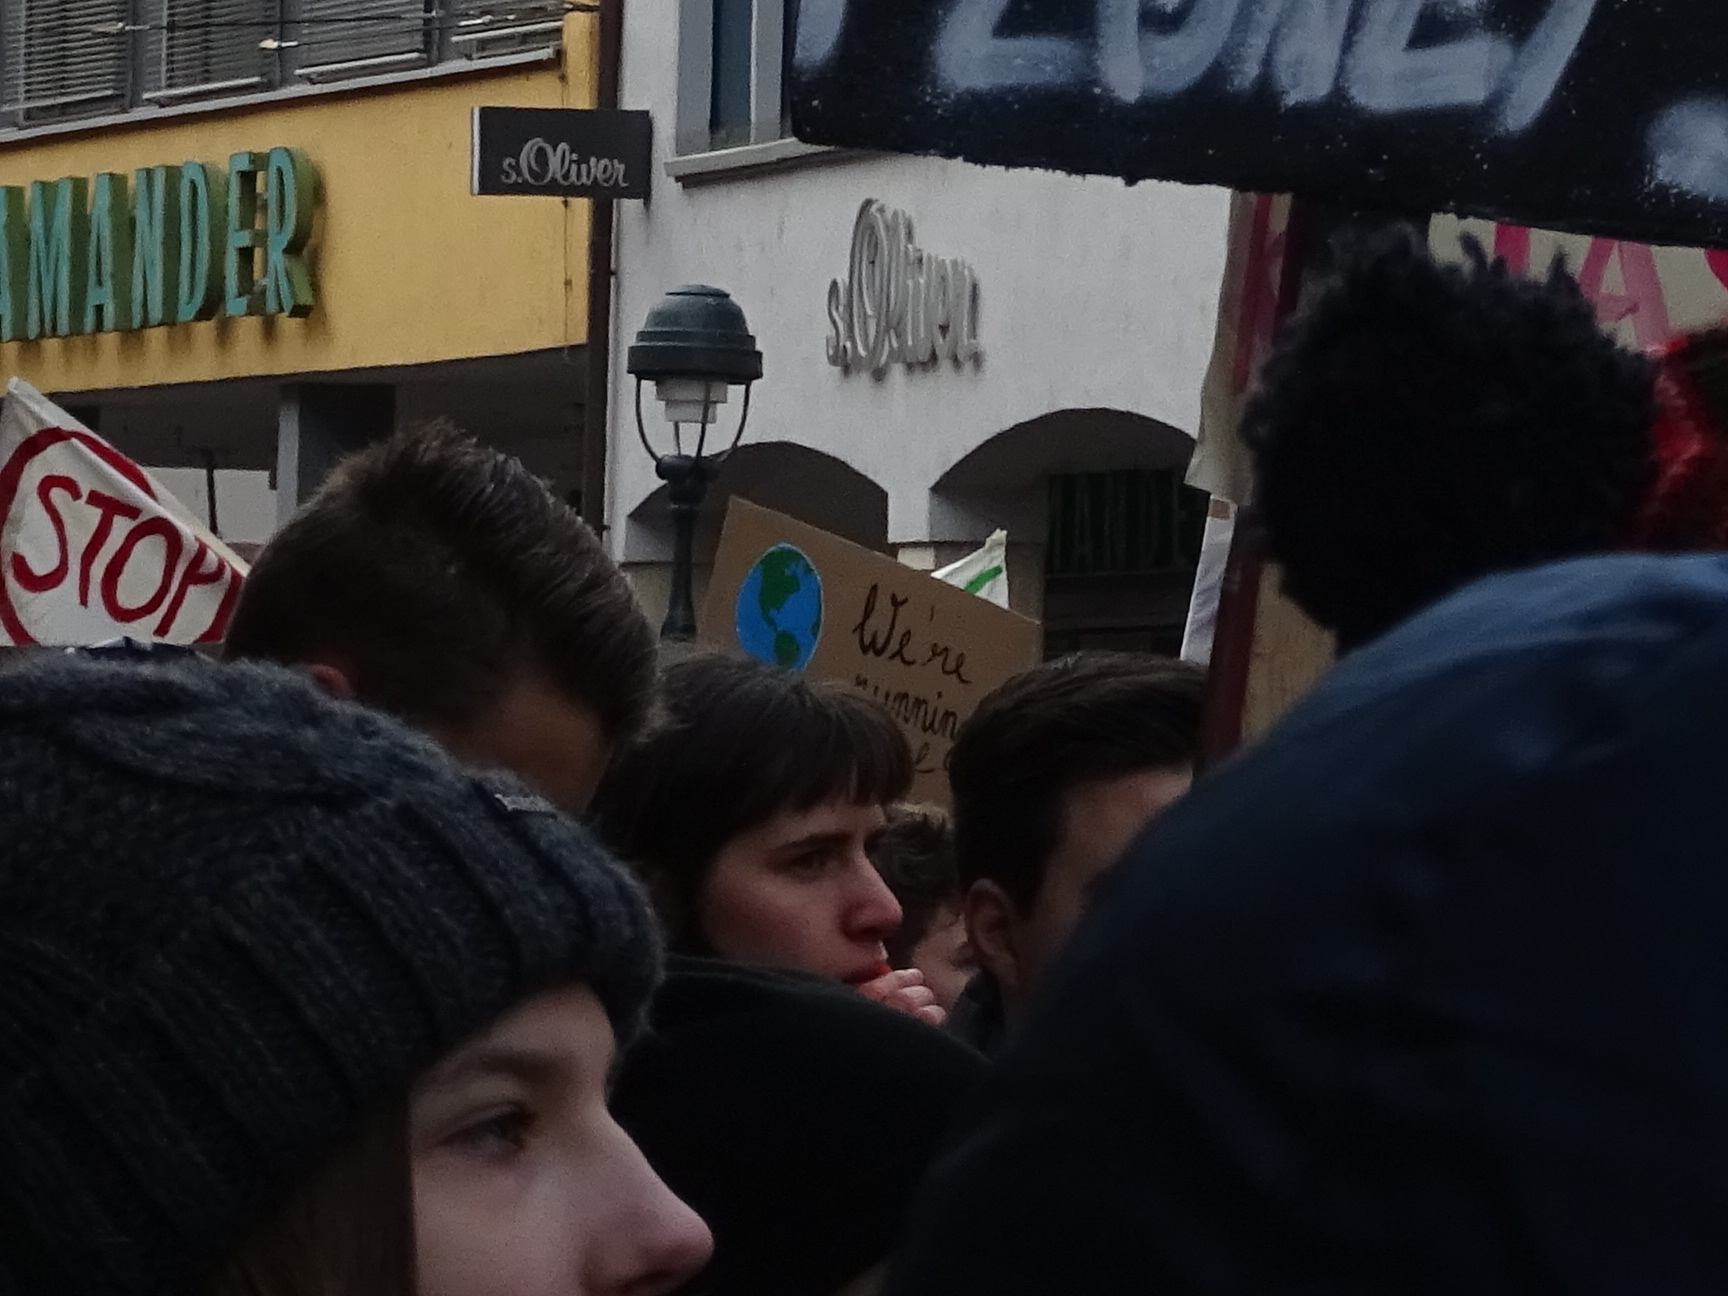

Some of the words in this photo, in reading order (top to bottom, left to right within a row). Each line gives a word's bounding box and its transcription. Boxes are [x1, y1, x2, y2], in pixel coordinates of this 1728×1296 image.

[501, 137, 630, 187] s.Oliver
[12, 474, 227, 638] STOP
[853, 582, 972, 684] We're
